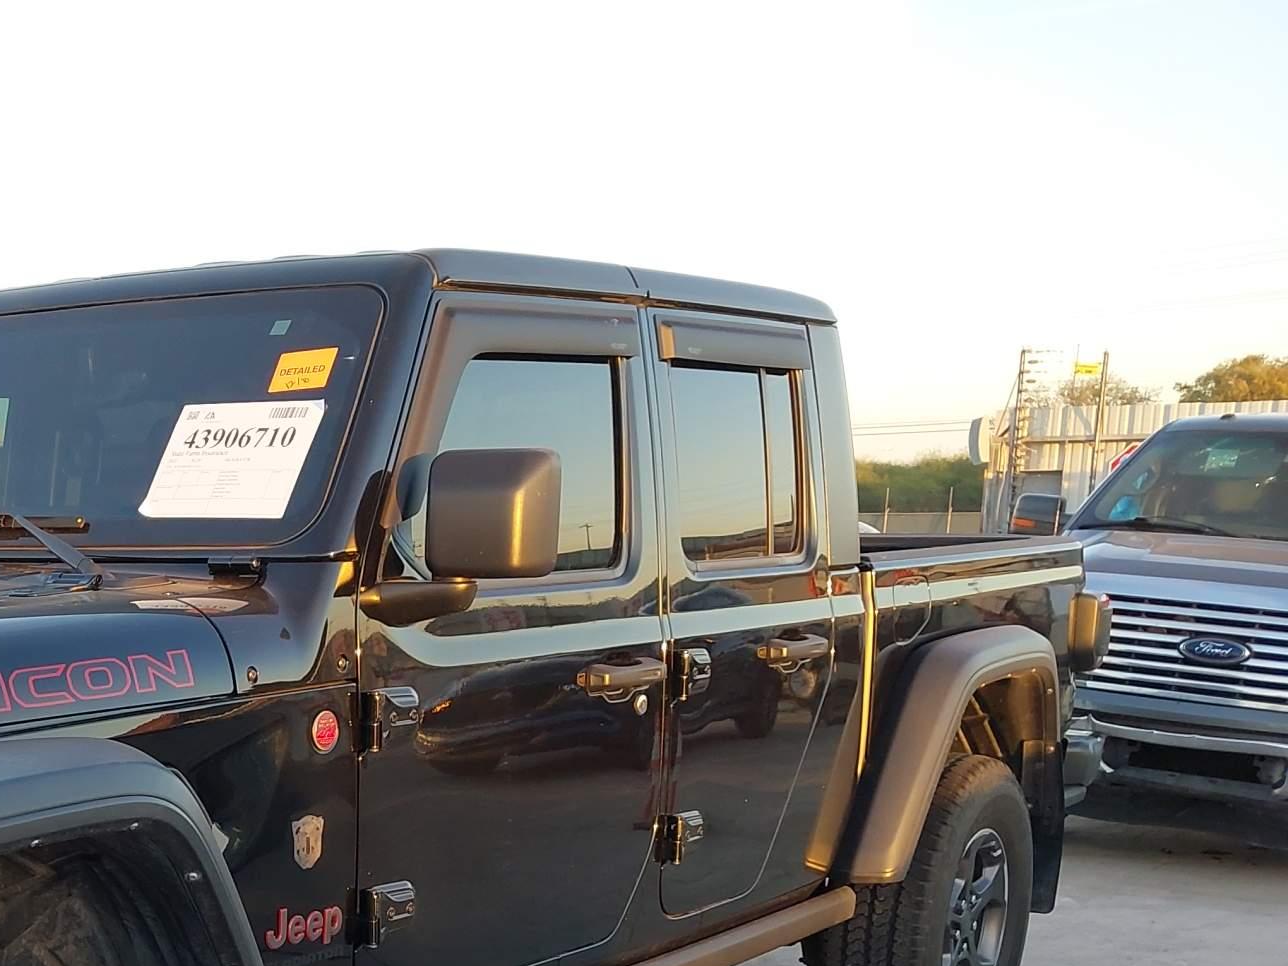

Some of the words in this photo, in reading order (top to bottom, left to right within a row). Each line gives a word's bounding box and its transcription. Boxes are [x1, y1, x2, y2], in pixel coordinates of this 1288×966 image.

[280, 365, 326, 376] DETAILED
[184, 426, 296, 449] 43906710
[1194, 641, 1233, 655] Ford
[266, 904, 343, 950] Jeep
